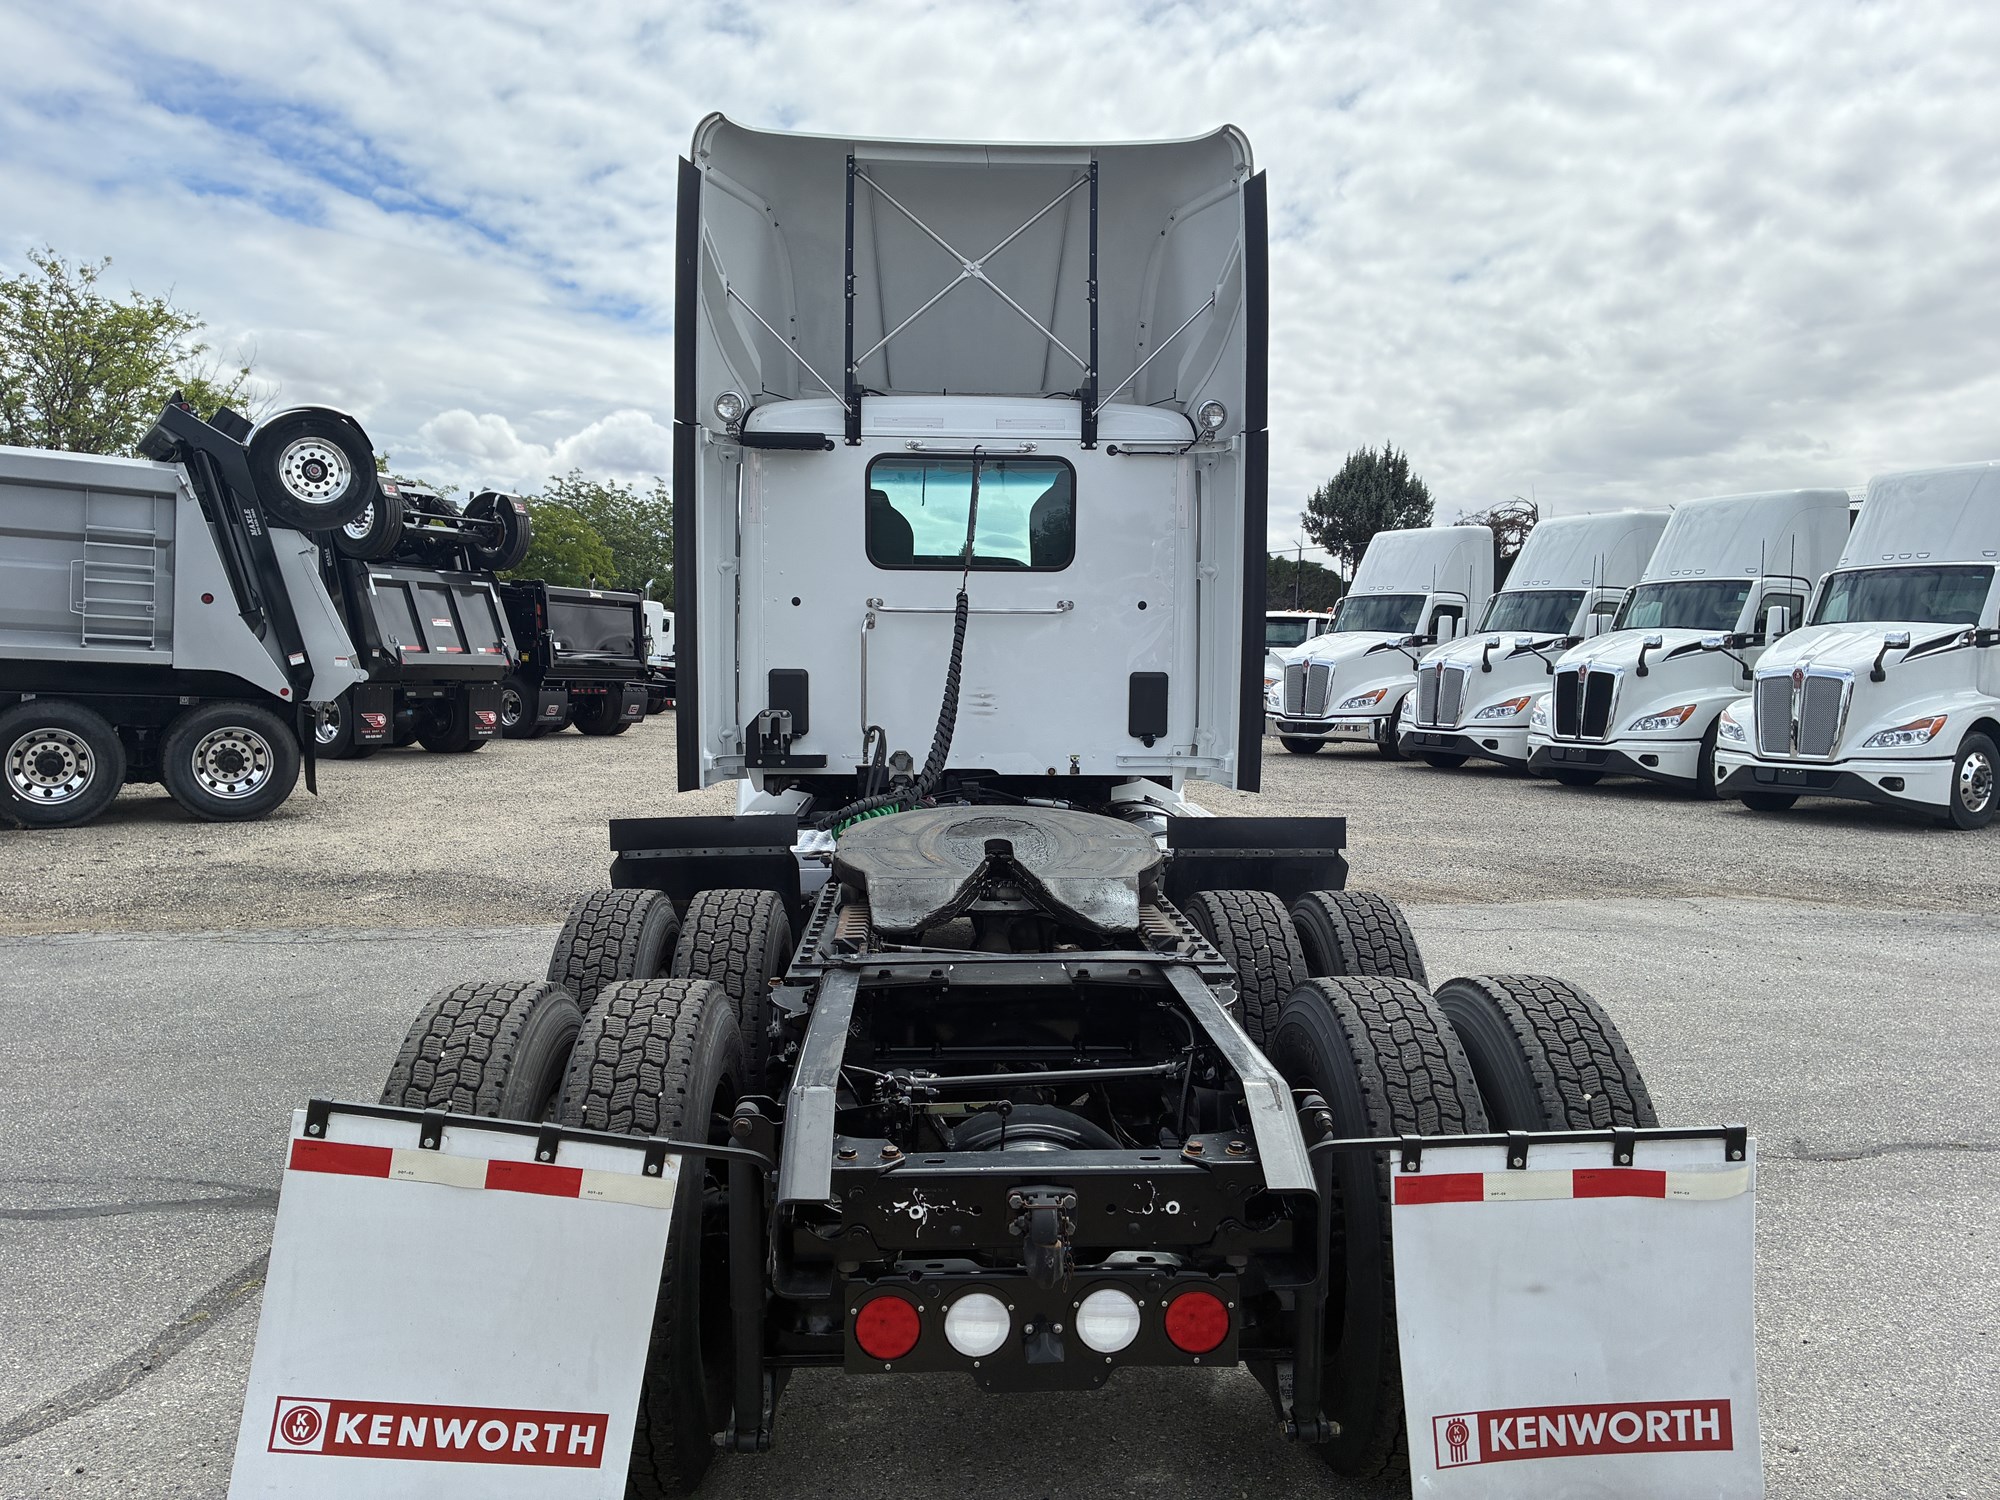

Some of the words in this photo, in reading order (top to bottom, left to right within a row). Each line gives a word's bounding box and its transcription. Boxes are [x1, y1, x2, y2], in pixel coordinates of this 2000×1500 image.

[243, 508, 259, 536] MAXLE
[334, 1412, 597, 1456] KENWORTH
[1489, 1408, 1720, 1452] KENWORTH
